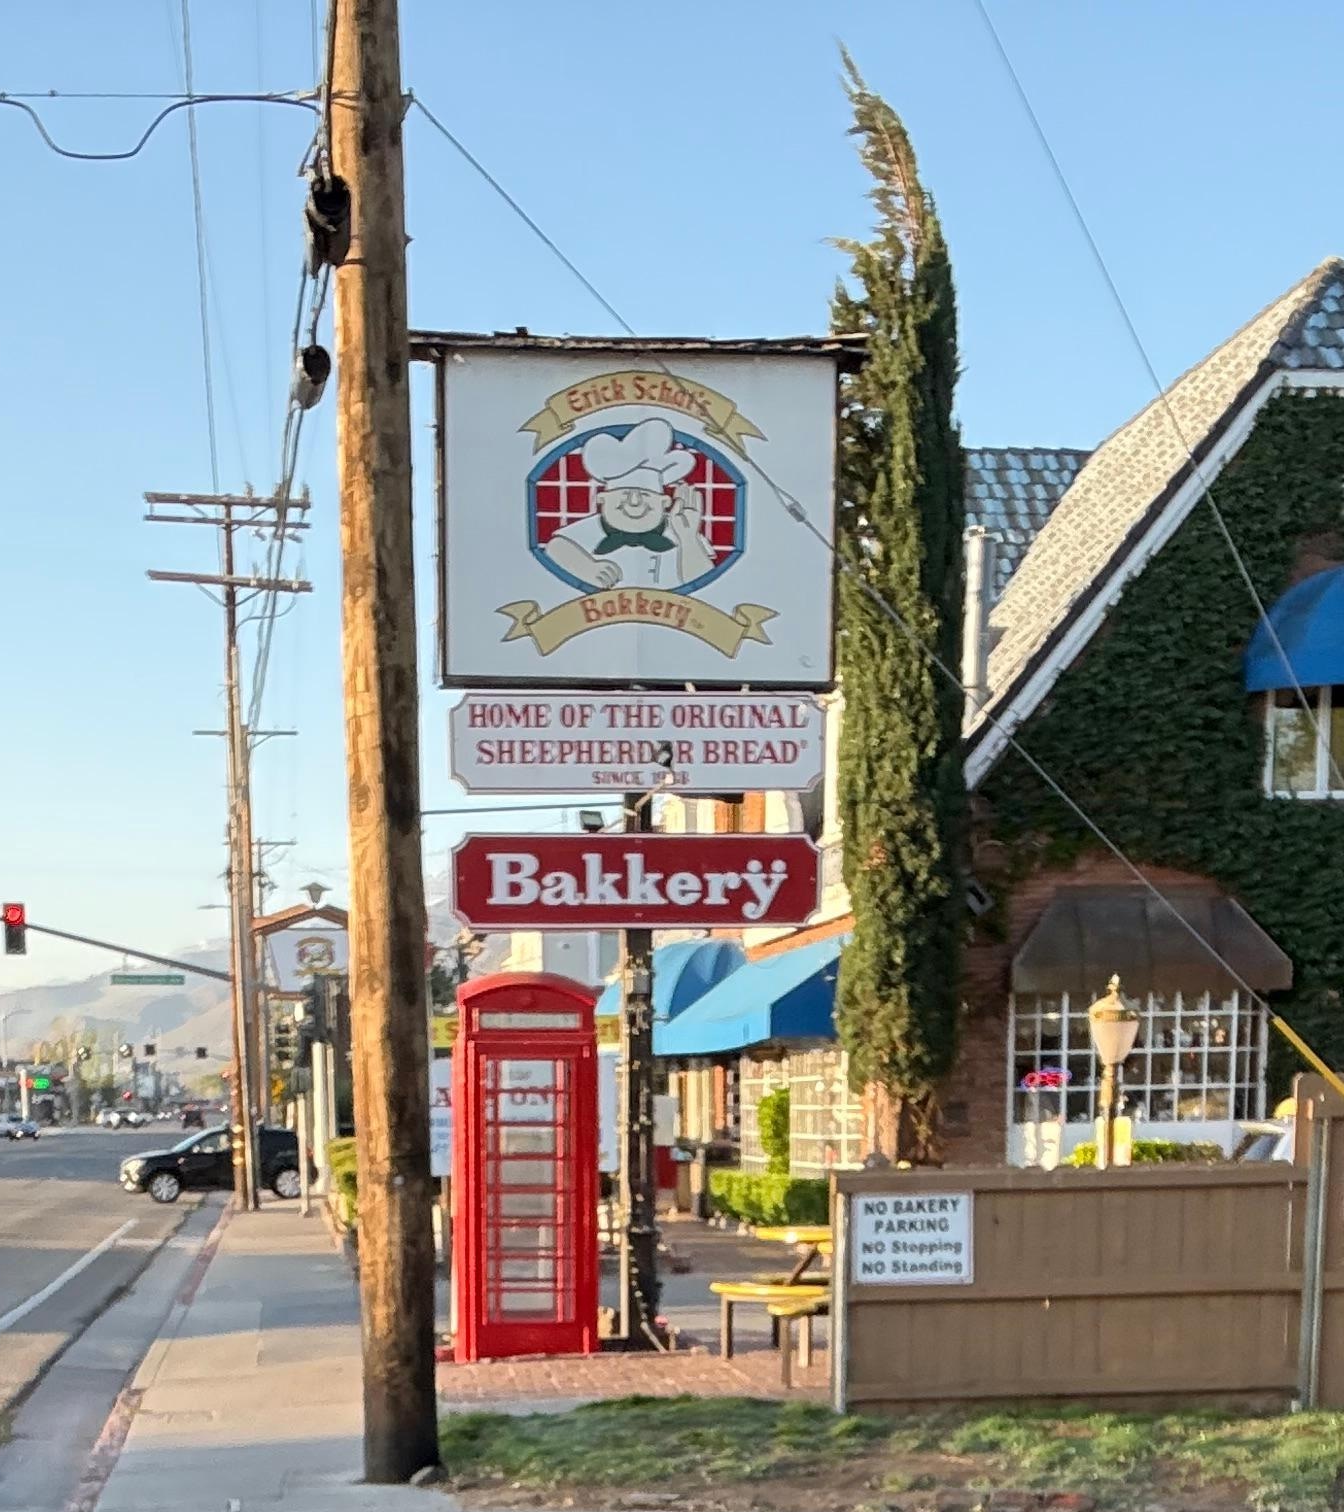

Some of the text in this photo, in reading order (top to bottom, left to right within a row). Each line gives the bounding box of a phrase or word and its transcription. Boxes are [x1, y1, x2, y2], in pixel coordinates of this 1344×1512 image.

[567, 378, 626, 412] Erick
[468, 703, 809, 729] HOME OF THE ORIGINAL
[476, 739, 694, 764] SHEEPHERDR
[864, 1199, 960, 1215] NO BAKERY
[874, 1217, 950, 1233] PARKING
[862, 1239, 963, 1255] NO Stopping
[862, 1259, 963, 1274] NO Standing
